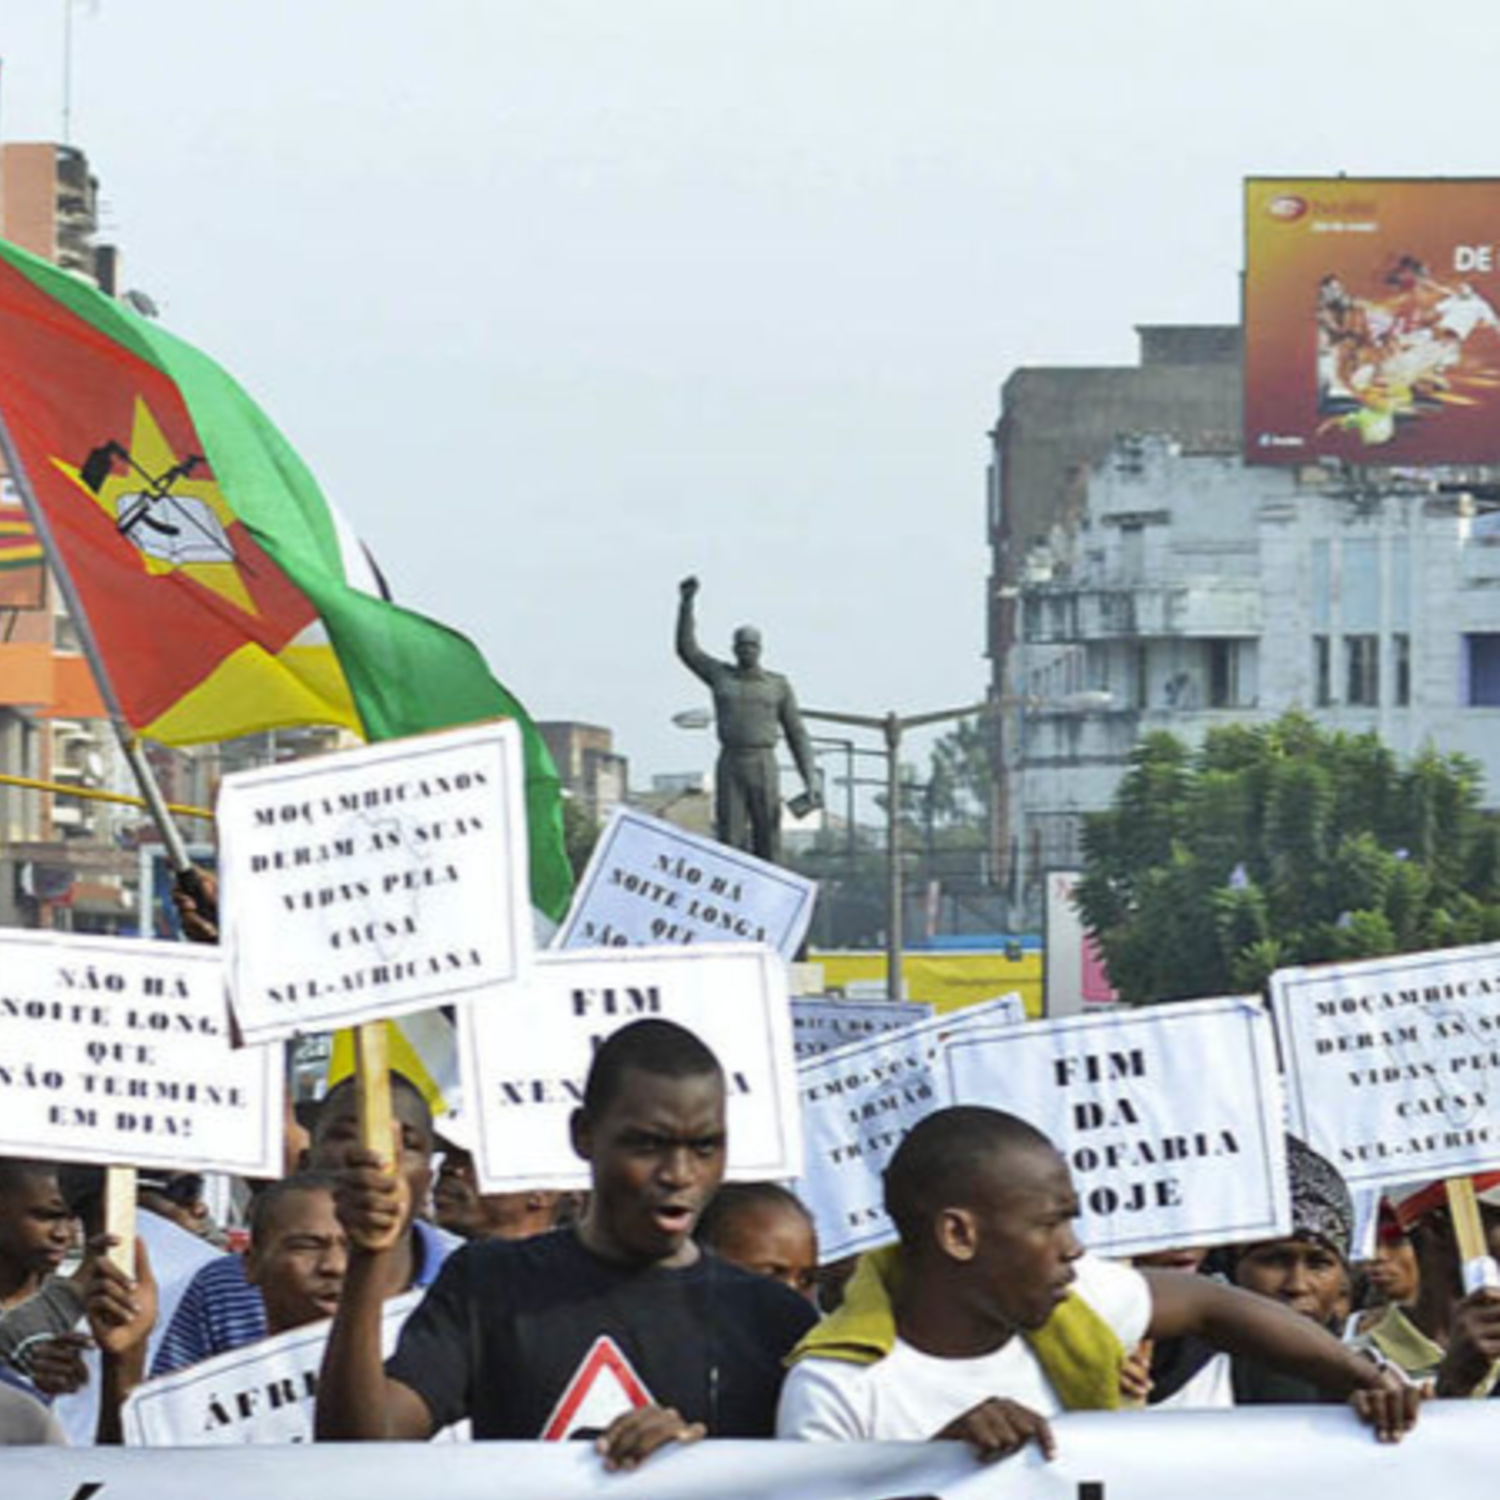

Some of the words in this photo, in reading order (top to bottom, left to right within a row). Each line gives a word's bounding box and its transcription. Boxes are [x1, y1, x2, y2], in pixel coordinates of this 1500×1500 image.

[1454, 245, 1493, 272] DE
[253, 771, 487, 827] MOÇAMBICANOS
[251, 838, 354, 872] DERAM
[383, 865, 458, 893] PELA
[608, 868, 680, 909] NOITE
[572, 986, 660, 1017] FIM
[1315, 977, 1500, 1017] MOÇAMBICA
[0, 997, 110, 1026] NOITE
[127, 1010, 229, 1037] LONG
[87, 1040, 156, 1066] QUE
[1315, 1025, 1417, 1056] DERAM
[1053, 1049, 1146, 1087] FIM
[1349, 1062, 1436, 1087] VIDAS
[78, 1072, 248, 1109] TERMINE
[1396, 1090, 1487, 1118] CAUSA
[49, 1104, 97, 1128] EM
[1074, 1098, 1139, 1131] DA
